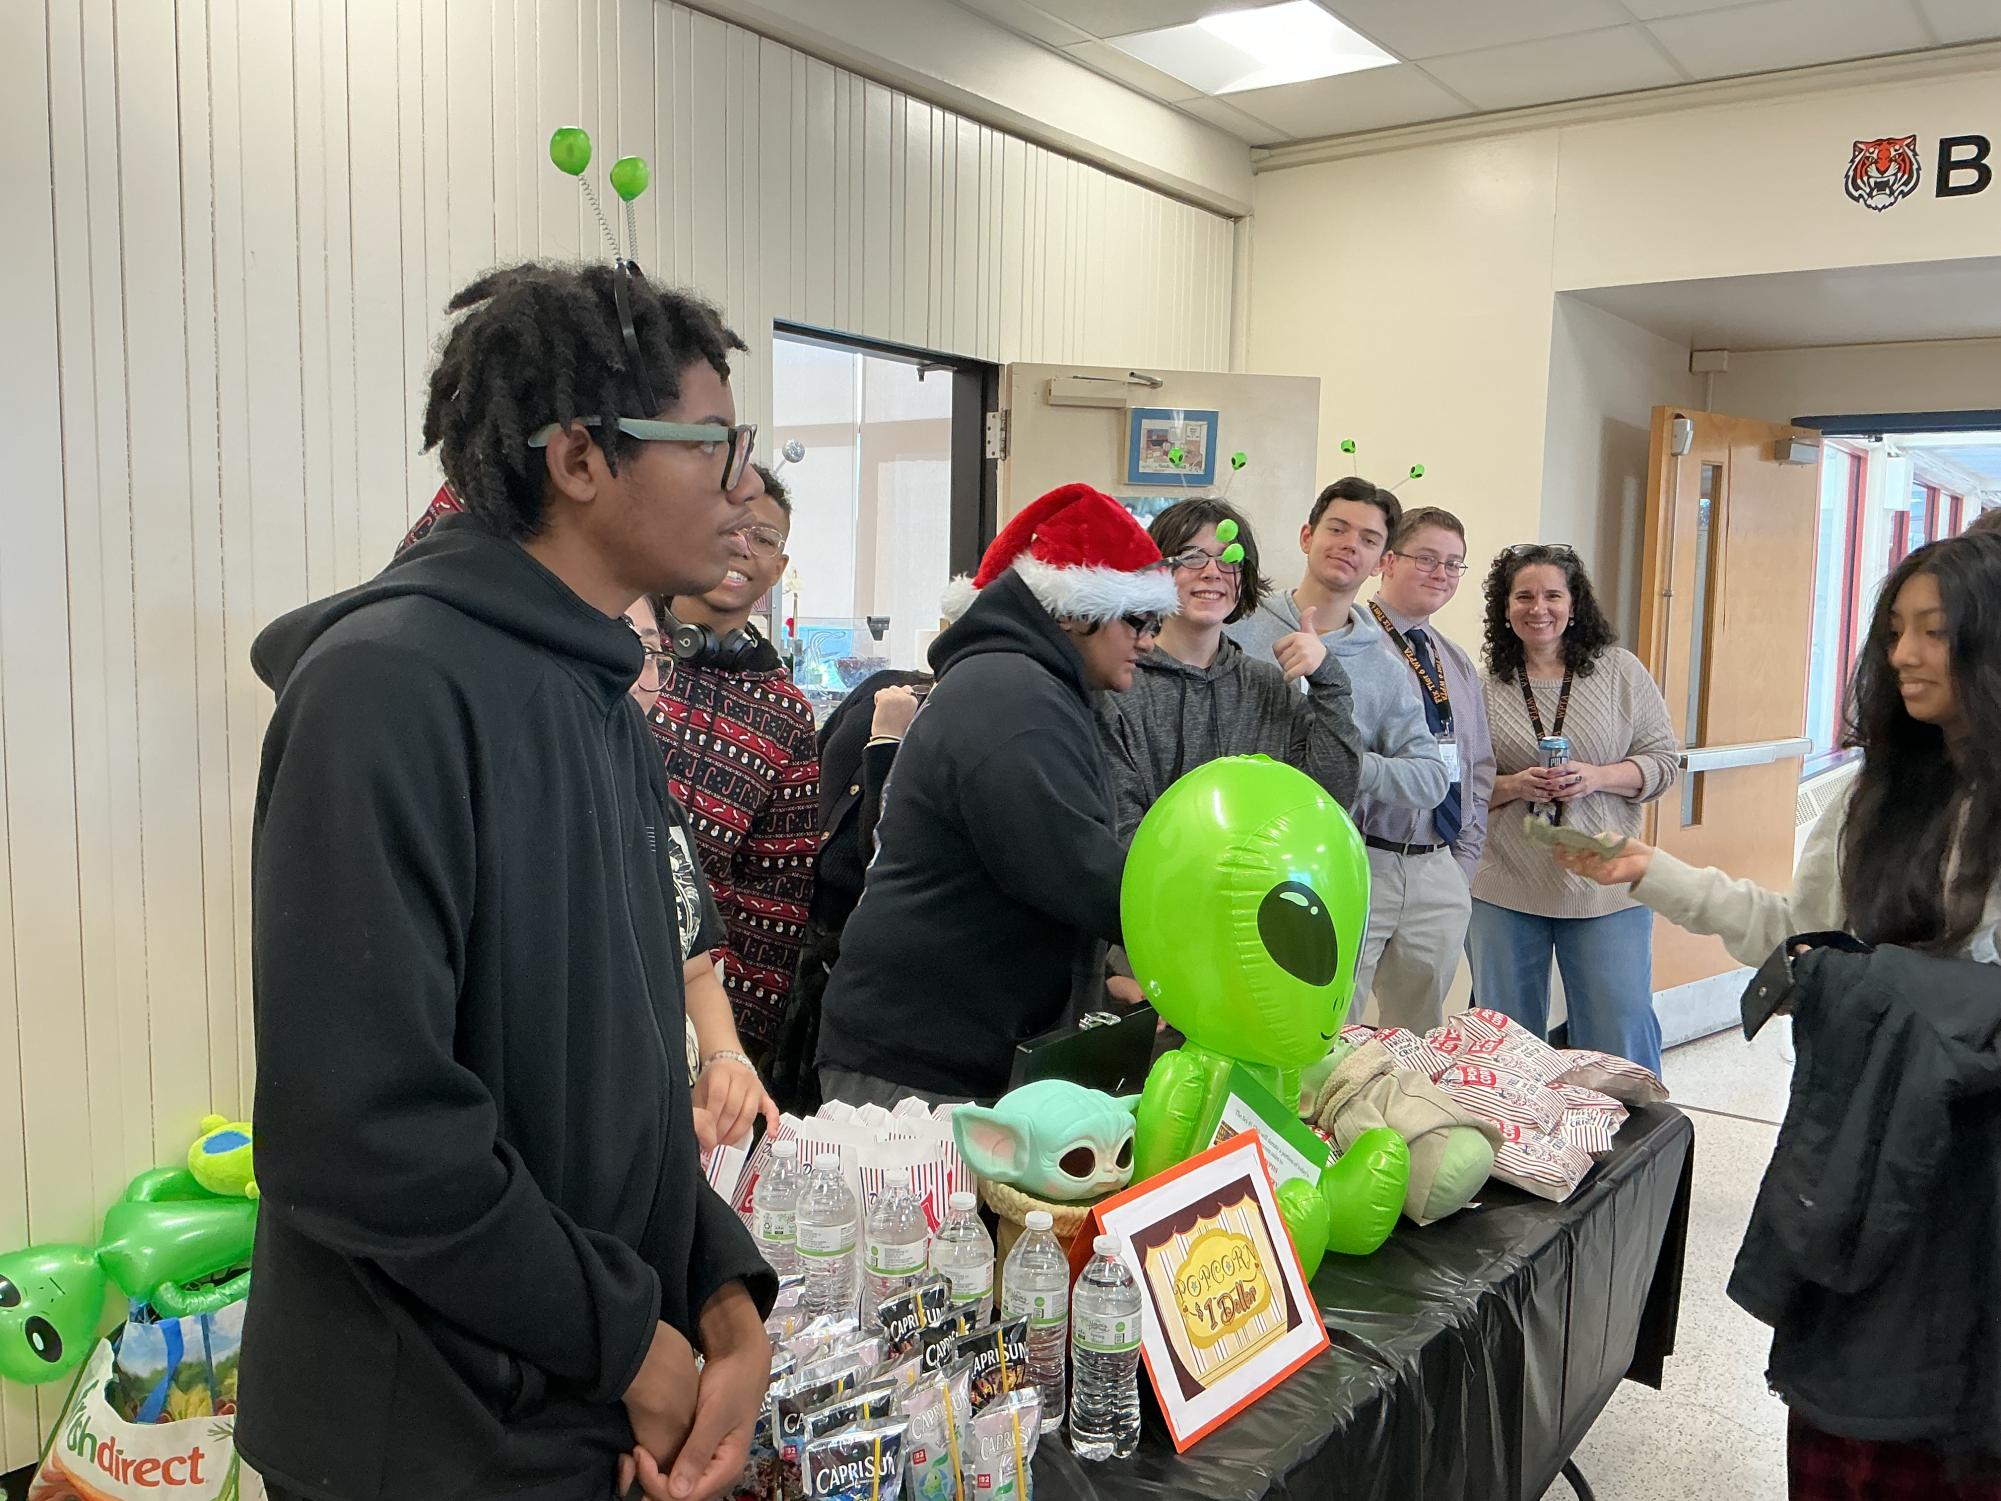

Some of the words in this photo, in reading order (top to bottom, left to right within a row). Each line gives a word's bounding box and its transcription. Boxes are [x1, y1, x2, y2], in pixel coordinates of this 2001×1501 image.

[1936, 134, 1993, 198] B
[1174, 1244, 1257, 1305] POPCORN
[1217, 1280, 1257, 1326] Dollar
